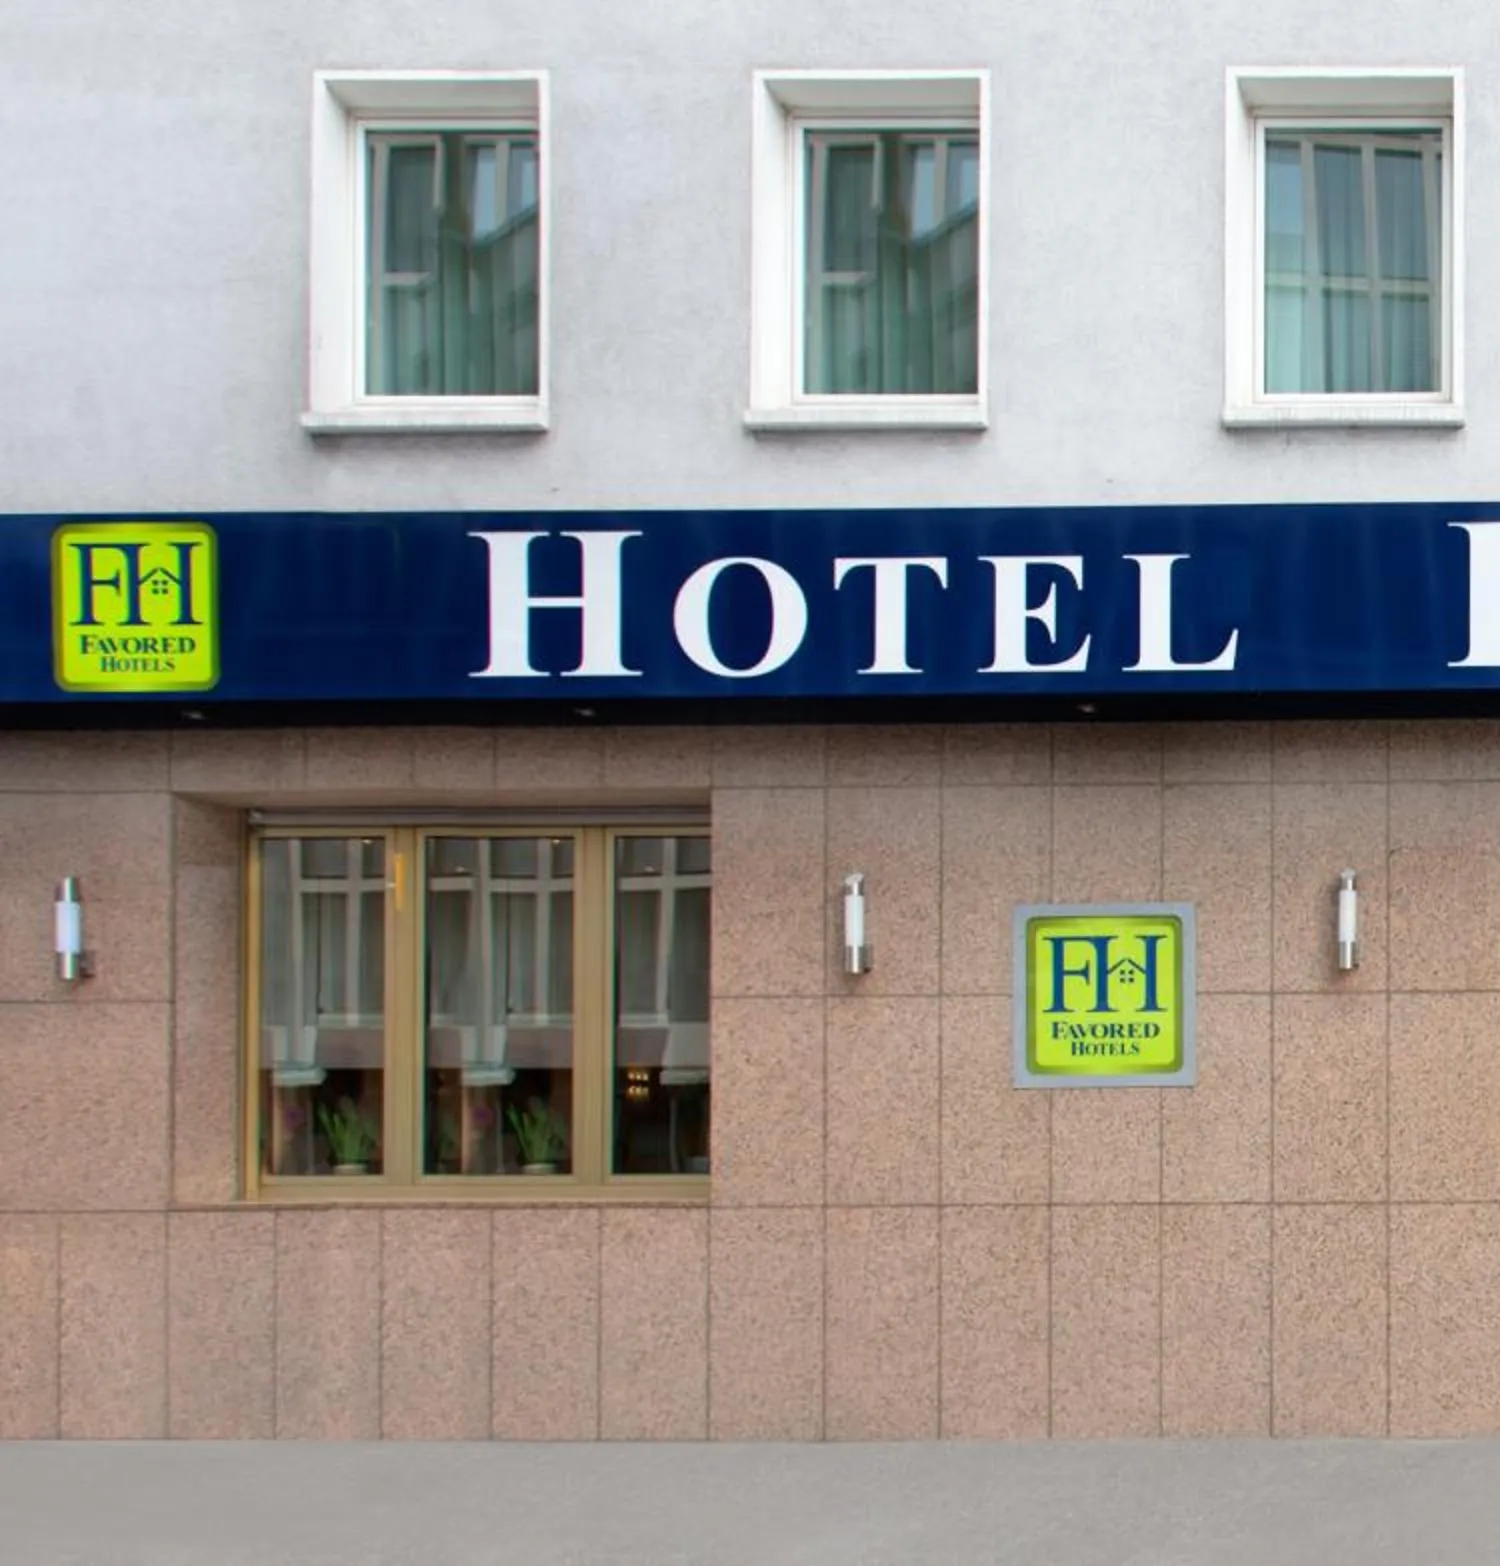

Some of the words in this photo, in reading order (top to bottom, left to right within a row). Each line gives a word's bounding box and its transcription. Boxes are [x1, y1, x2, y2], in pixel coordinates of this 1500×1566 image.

[467, 529, 1240, 679] HOTEL
[79, 633, 197, 655] FAVORED
[100, 656, 176, 673] HOTELS
[1052, 1021, 1161, 1040] FAVORED
[1071, 1041, 1140, 1057] HOTELS
